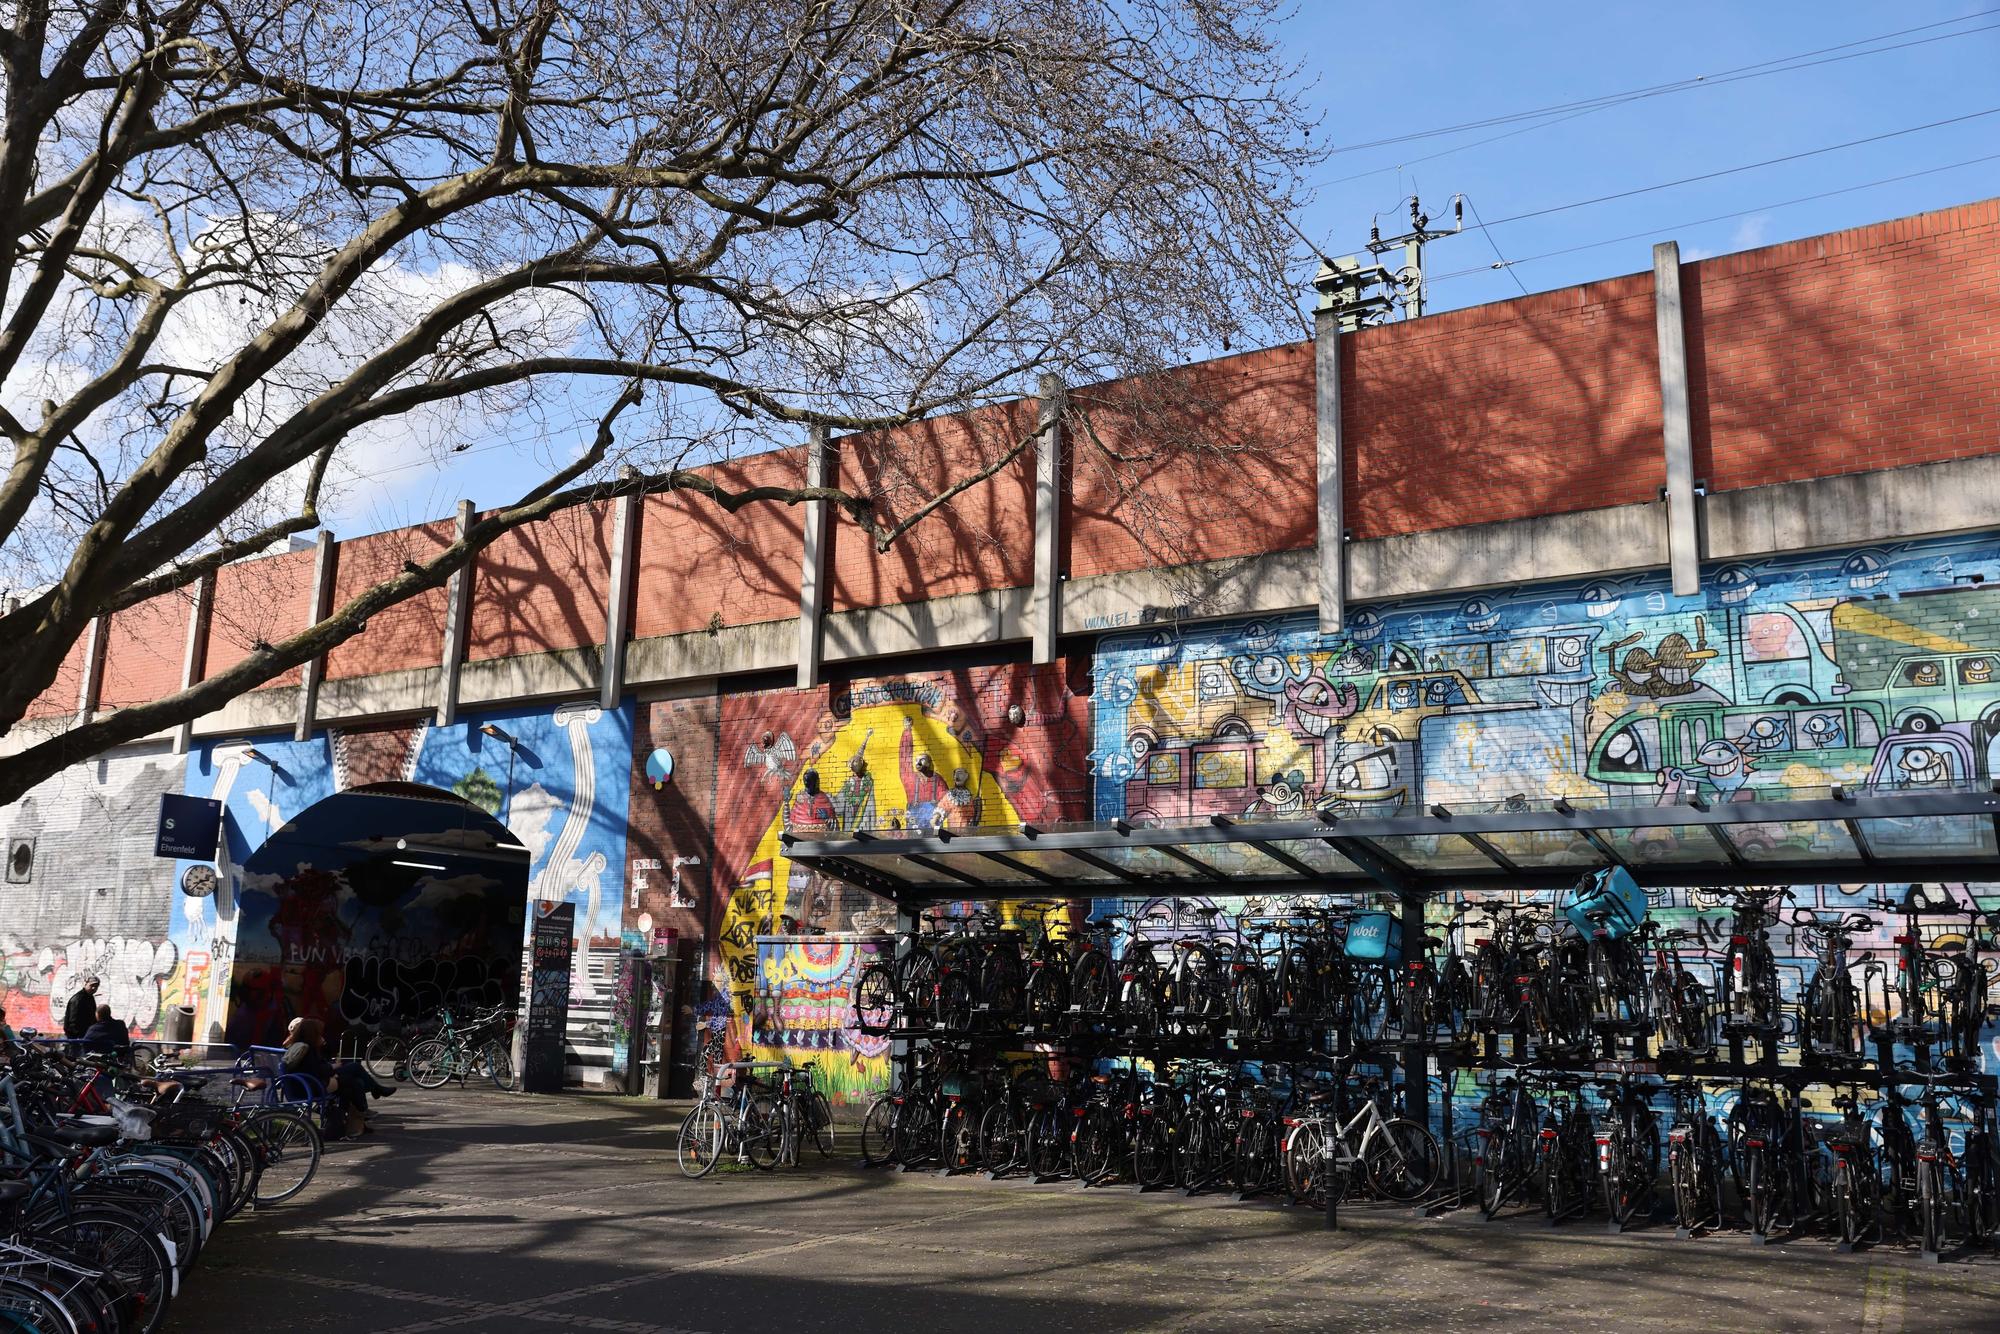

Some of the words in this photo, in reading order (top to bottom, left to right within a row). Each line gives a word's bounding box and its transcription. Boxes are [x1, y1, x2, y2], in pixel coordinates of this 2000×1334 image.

[165, 818, 175, 829] S
[161, 844, 196, 854] Ehrenfeld
[1353, 925, 1379, 938] Wolt
[291, 943, 326, 963] FUN
